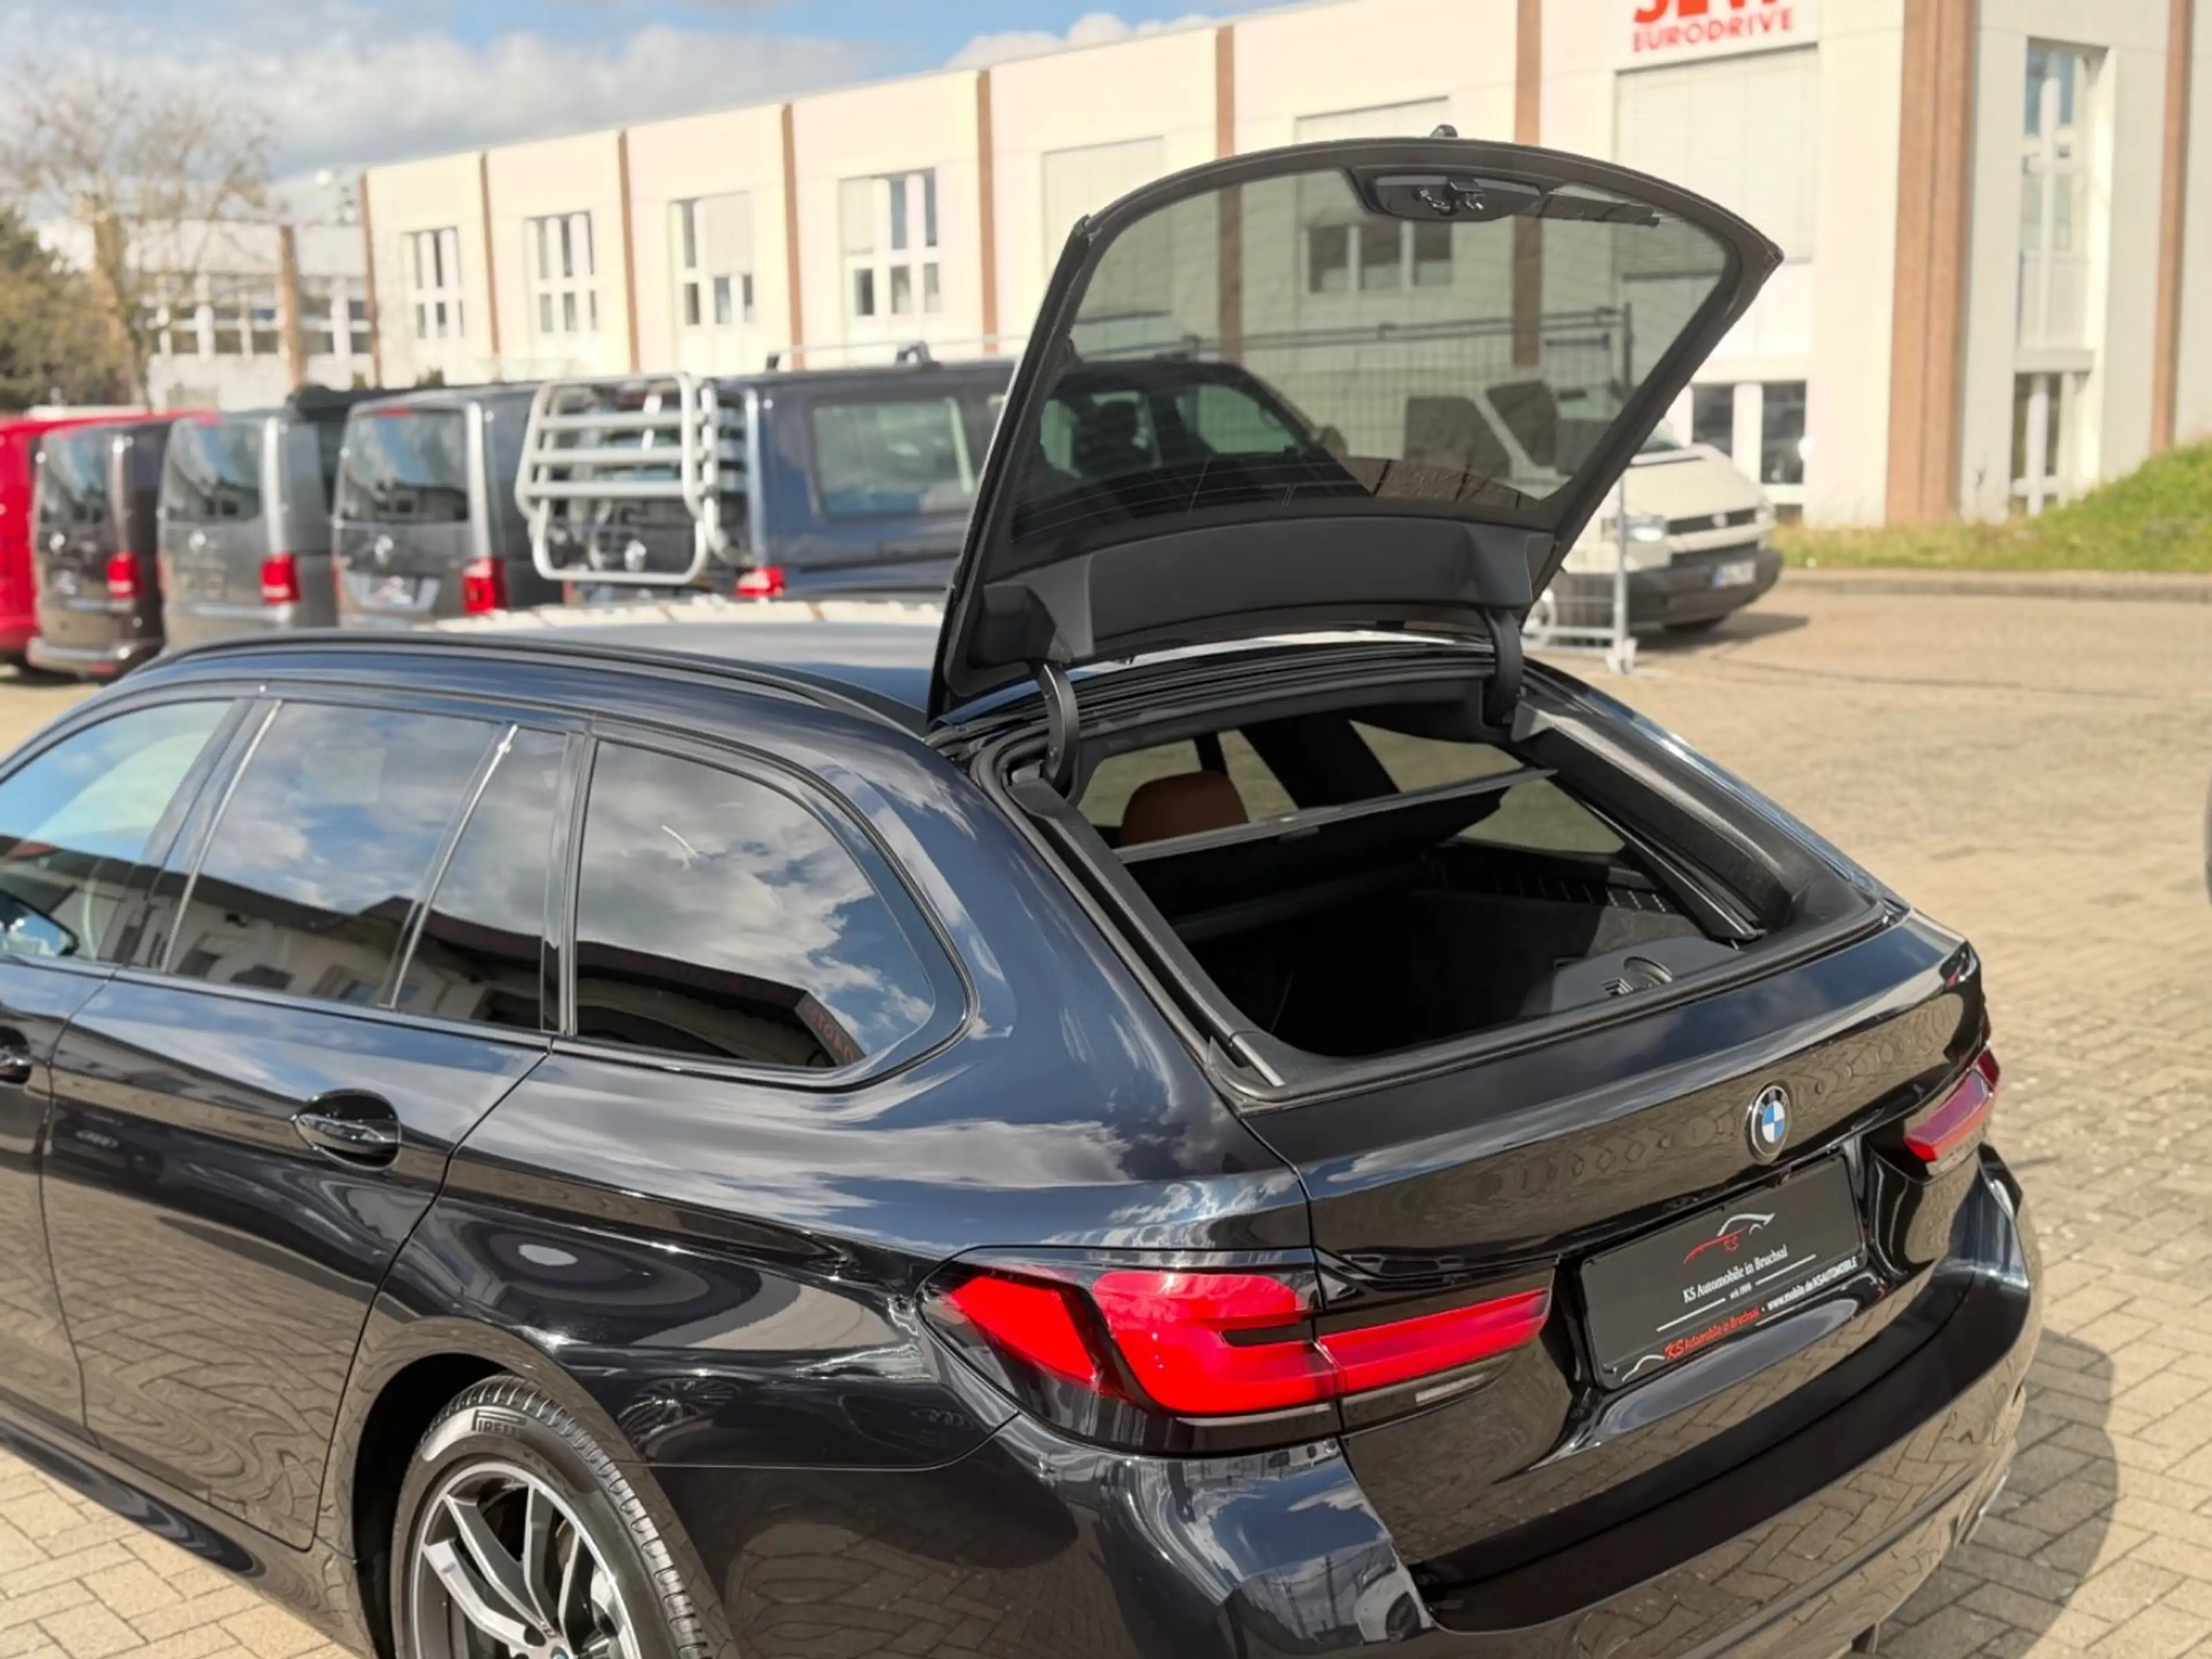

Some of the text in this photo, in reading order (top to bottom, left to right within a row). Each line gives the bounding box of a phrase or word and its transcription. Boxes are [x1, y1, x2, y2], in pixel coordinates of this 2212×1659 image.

[1633, 7, 1794, 52] EURODRIVE
[1683, 1286, 1696, 1304] KS
[1698, 1266, 1744, 1297] Automobile
[1745, 1262, 1754, 1275] in
[1754, 1243, 1788, 1271] Bruchsal
